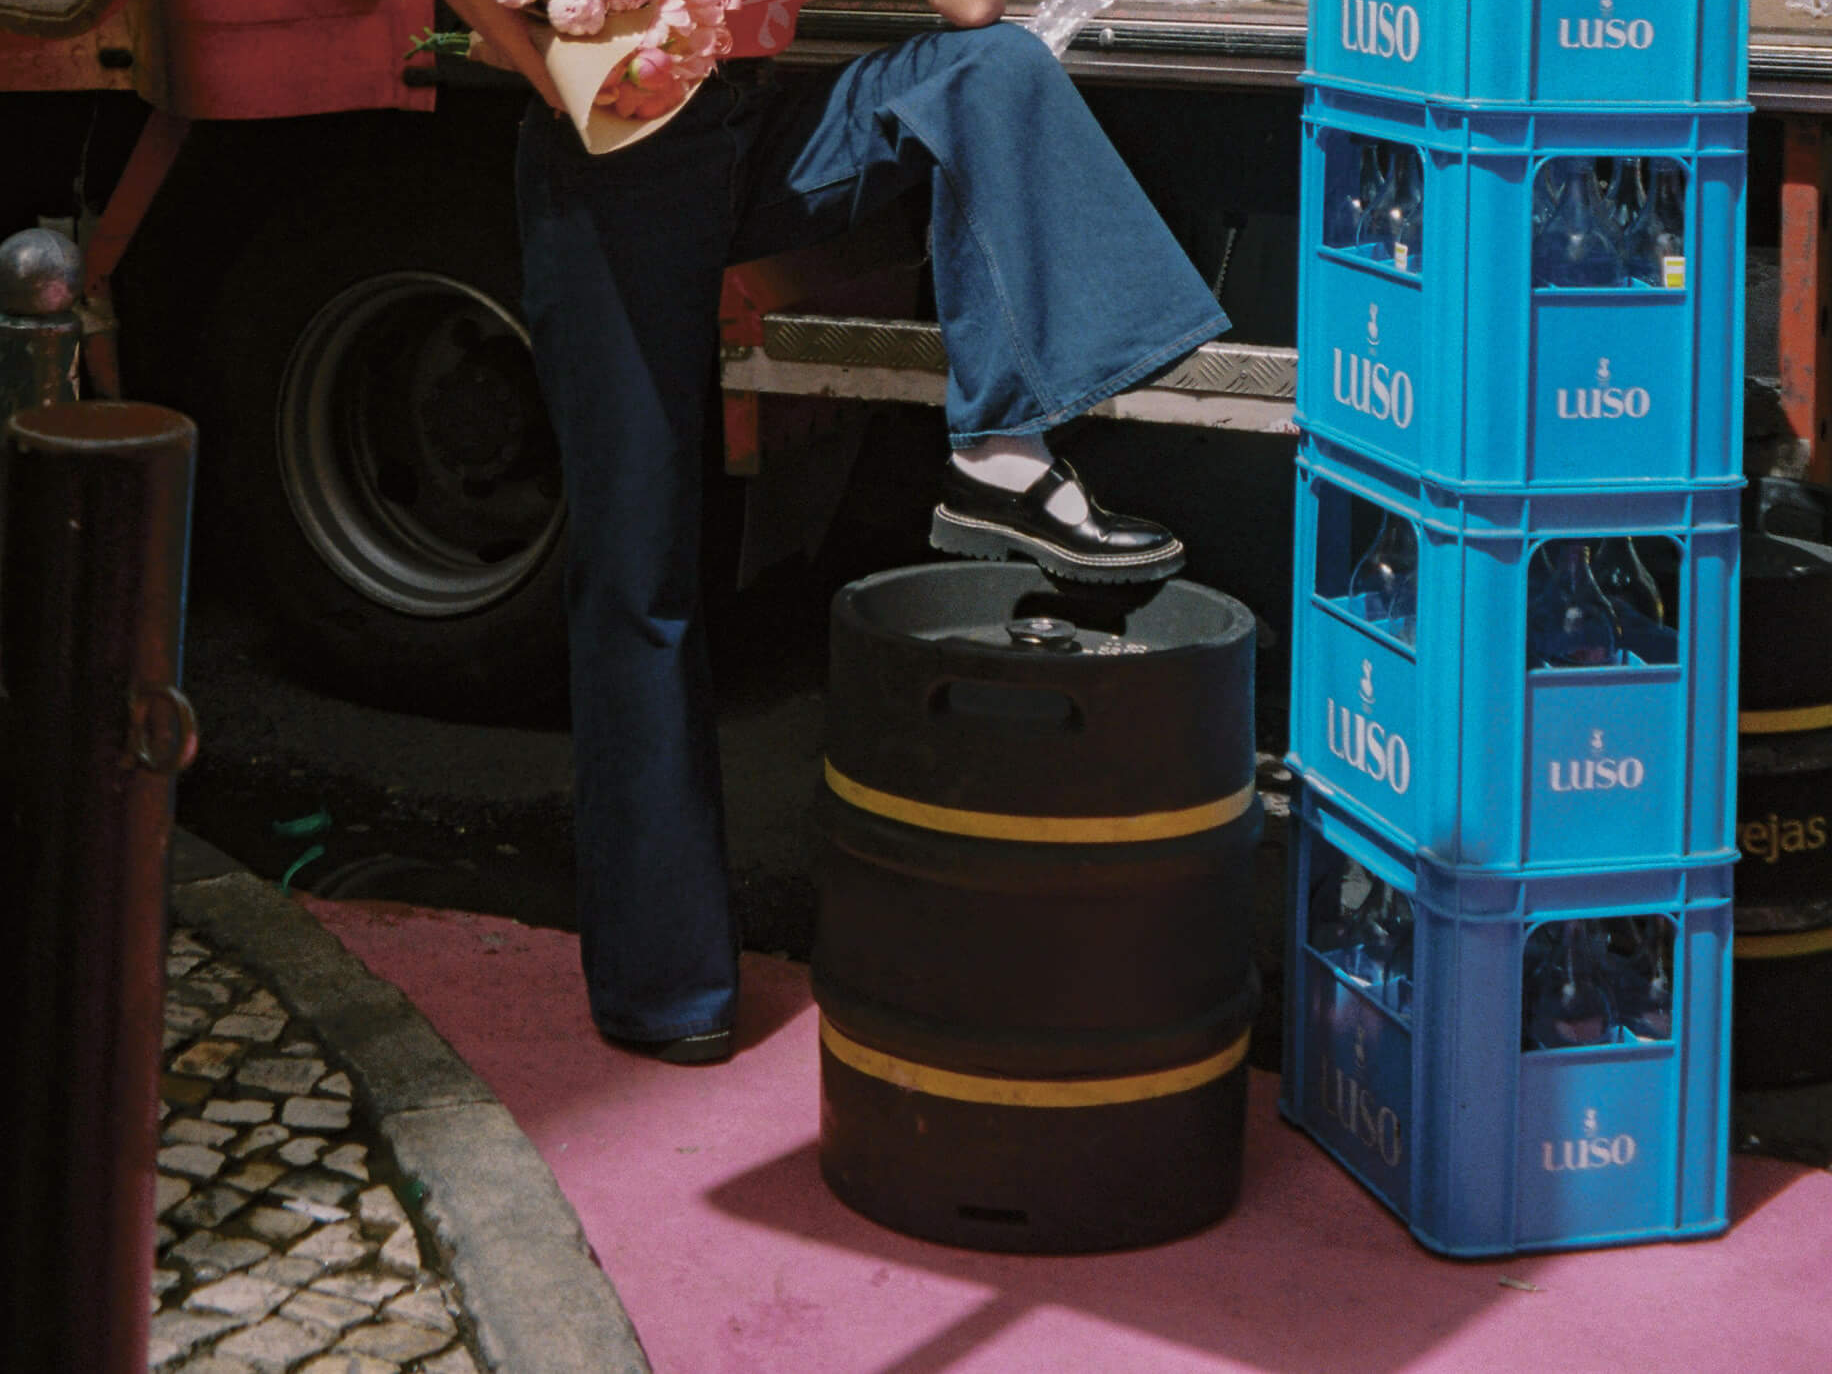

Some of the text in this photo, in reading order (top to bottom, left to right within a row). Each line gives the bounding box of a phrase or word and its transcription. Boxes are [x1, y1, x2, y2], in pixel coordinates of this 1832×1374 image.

[1558, 18, 1655, 50] LUSO
[1333, 348, 1413, 430] LUSO
[1556, 386, 1650, 419] LUSO
[1326, 698, 1411, 795] LUSO
[1549, 757, 1644, 792] LUSO
[1321, 1055, 1400, 1168] LUSO
[1541, 1133, 1637, 1172] LUSO
